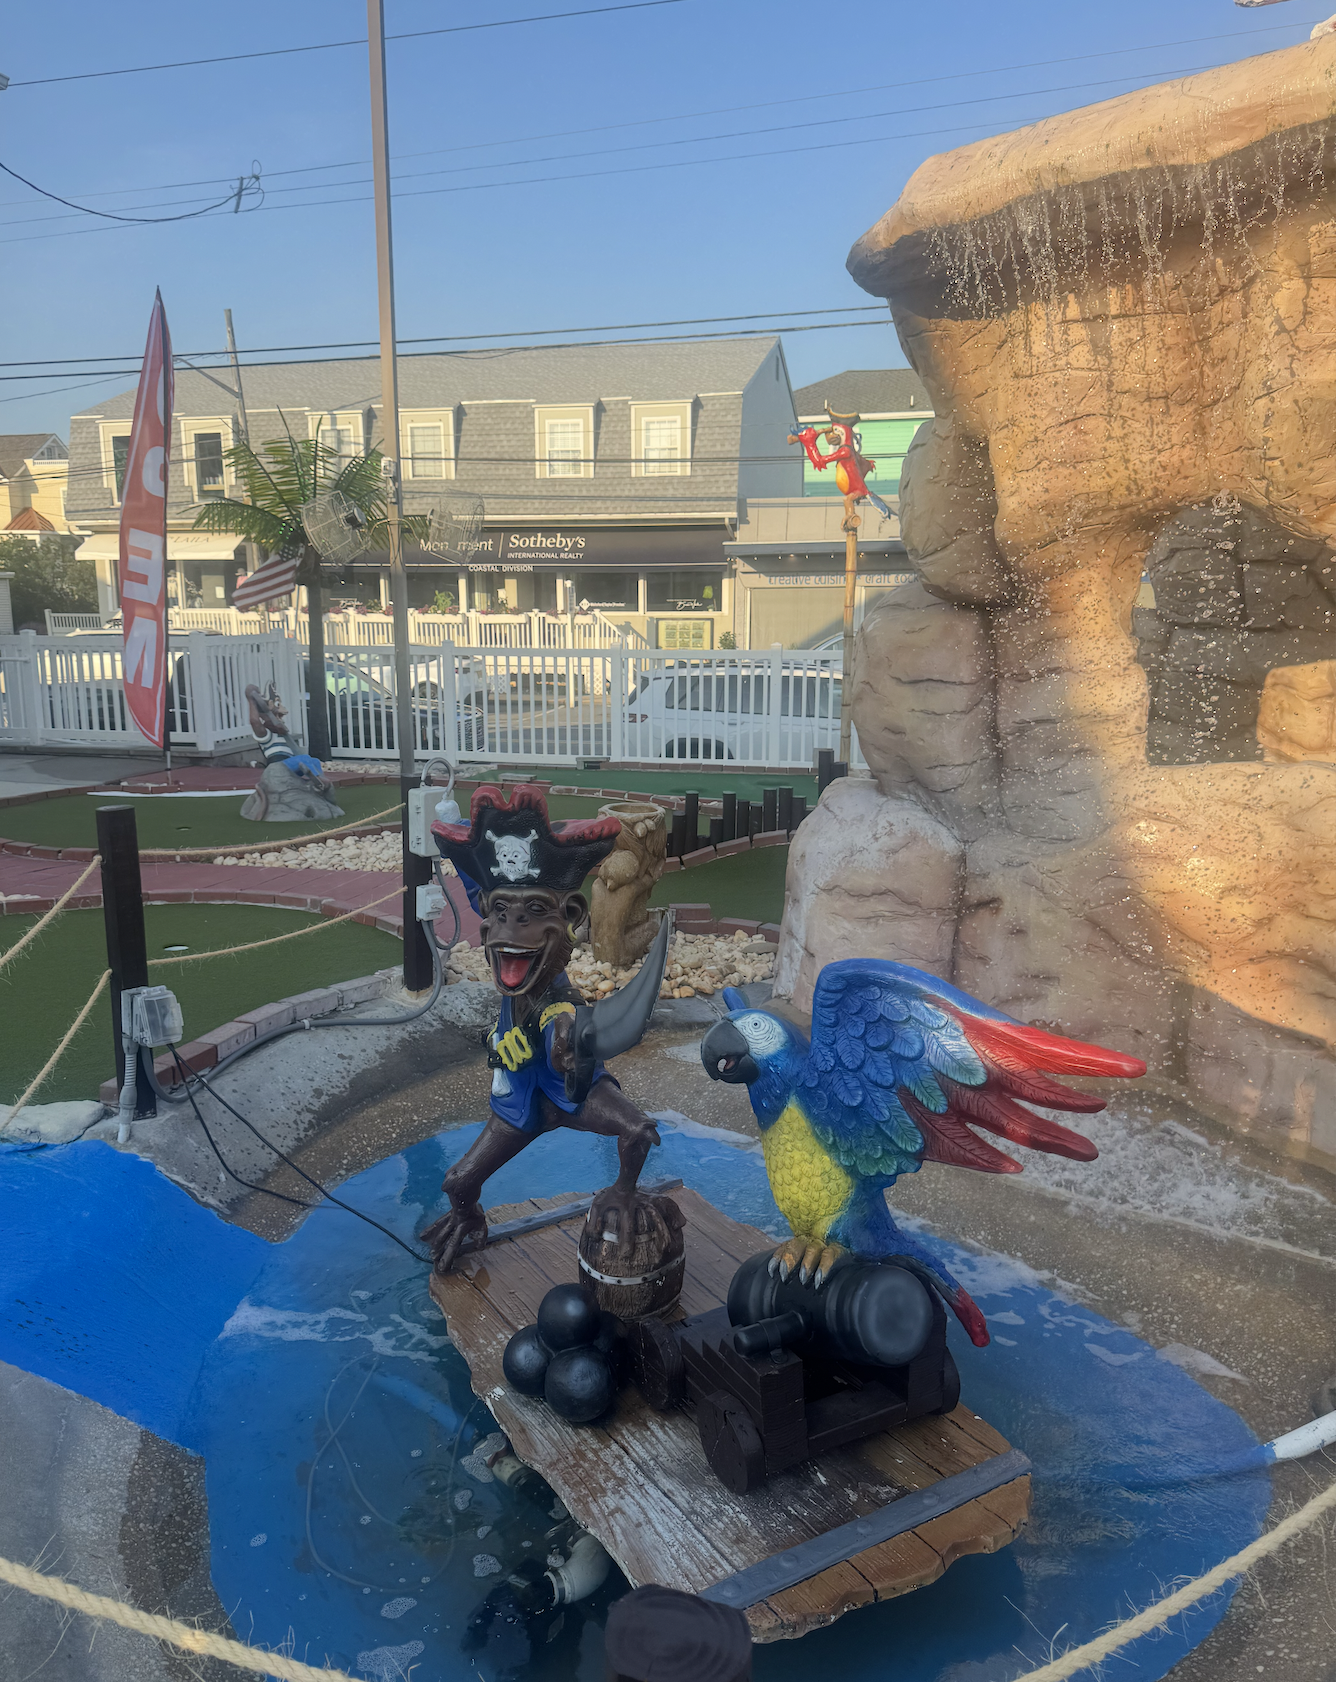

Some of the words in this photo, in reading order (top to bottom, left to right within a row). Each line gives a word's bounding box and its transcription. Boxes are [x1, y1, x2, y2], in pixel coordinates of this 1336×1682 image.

[420, 538, 494, 552] Monment
[508, 532, 586, 551] Sotheby's
[559, 552, 584, 560] REALTY
[768, 574, 811, 585] creative
[814, 574, 846, 585] cuisin
